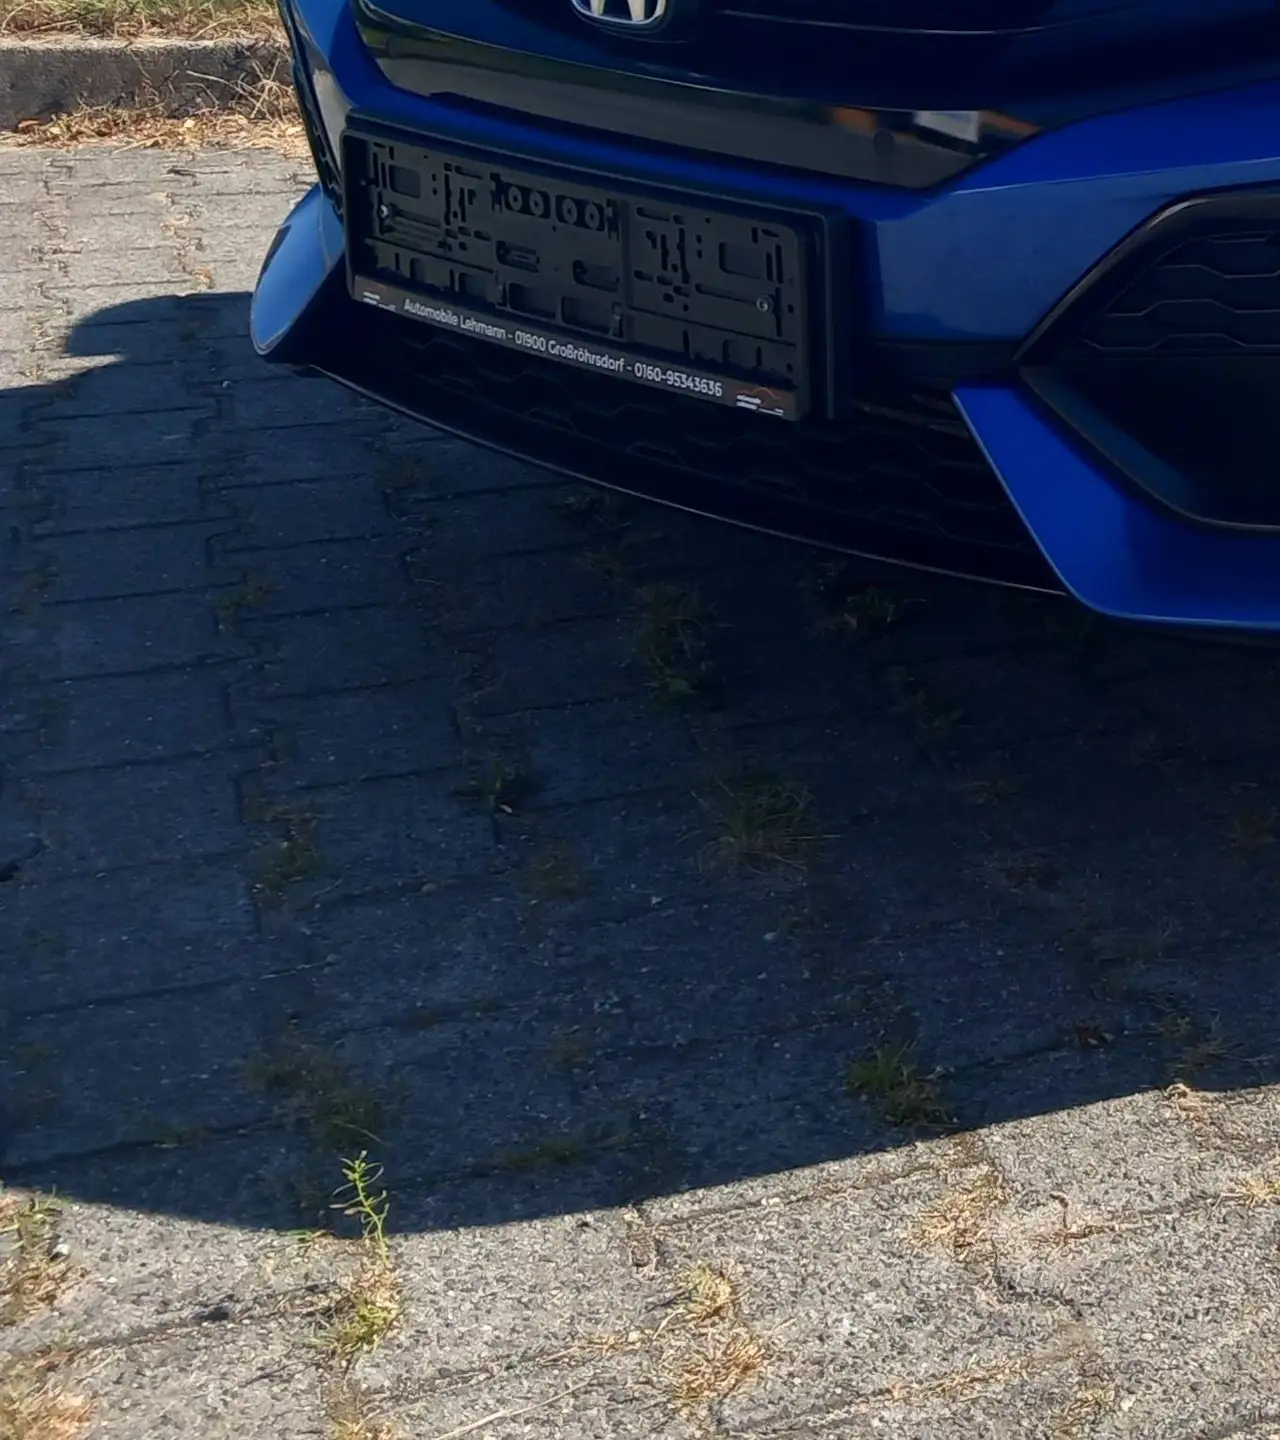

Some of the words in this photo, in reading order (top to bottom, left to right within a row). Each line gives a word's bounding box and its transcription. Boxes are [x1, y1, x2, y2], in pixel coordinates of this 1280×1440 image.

[403, 298, 458, 326] Automobile
[459, 314, 507, 341] Lehmann
[514, 332, 547, 352] 01900
[547, 339, 625, 373] Großröhrsdorf
[633, 362, 723, 397] 0160-95343636
